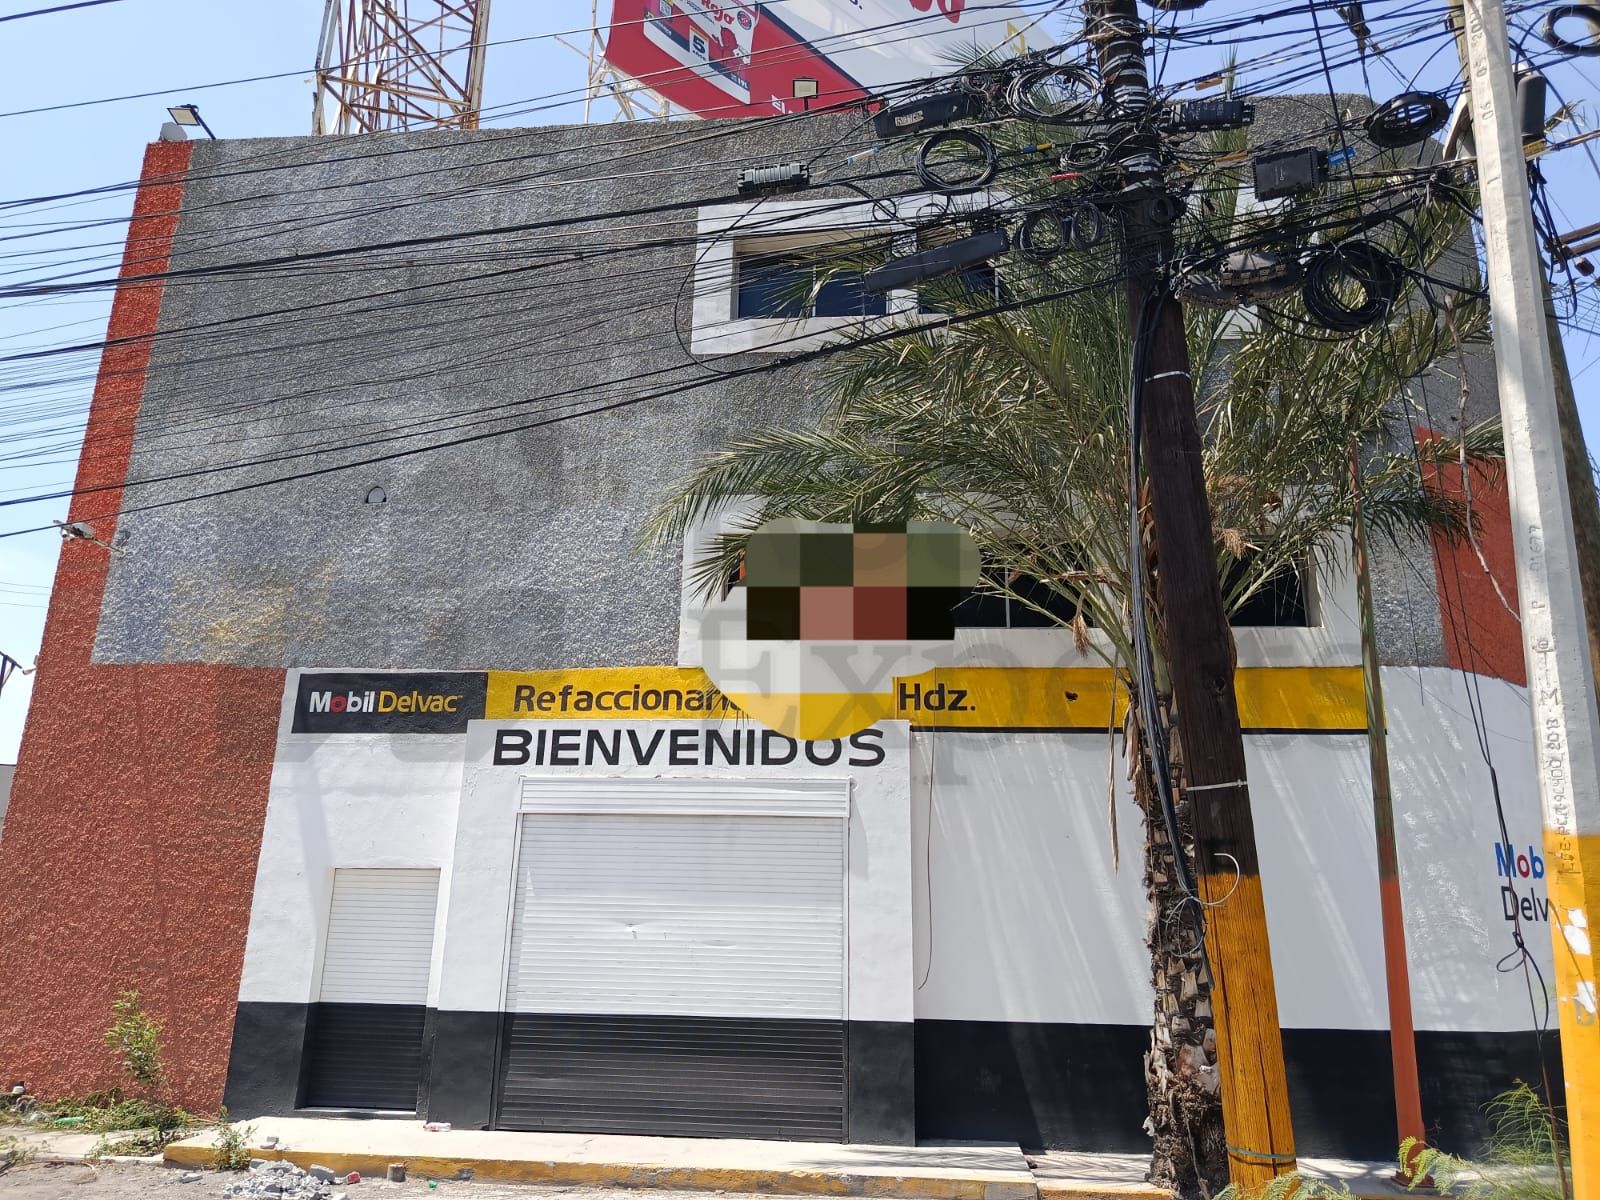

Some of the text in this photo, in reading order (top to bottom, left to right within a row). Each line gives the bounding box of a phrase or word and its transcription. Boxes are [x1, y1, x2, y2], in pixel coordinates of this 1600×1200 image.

[692, 35, 706, 54] 5
[309, 690, 458, 713] Mobil Delvac
[899, 682, 976, 712] Hdz.
[492, 728, 886, 767] BIENVENIDOS
[1495, 842, 1545, 879] Mob
